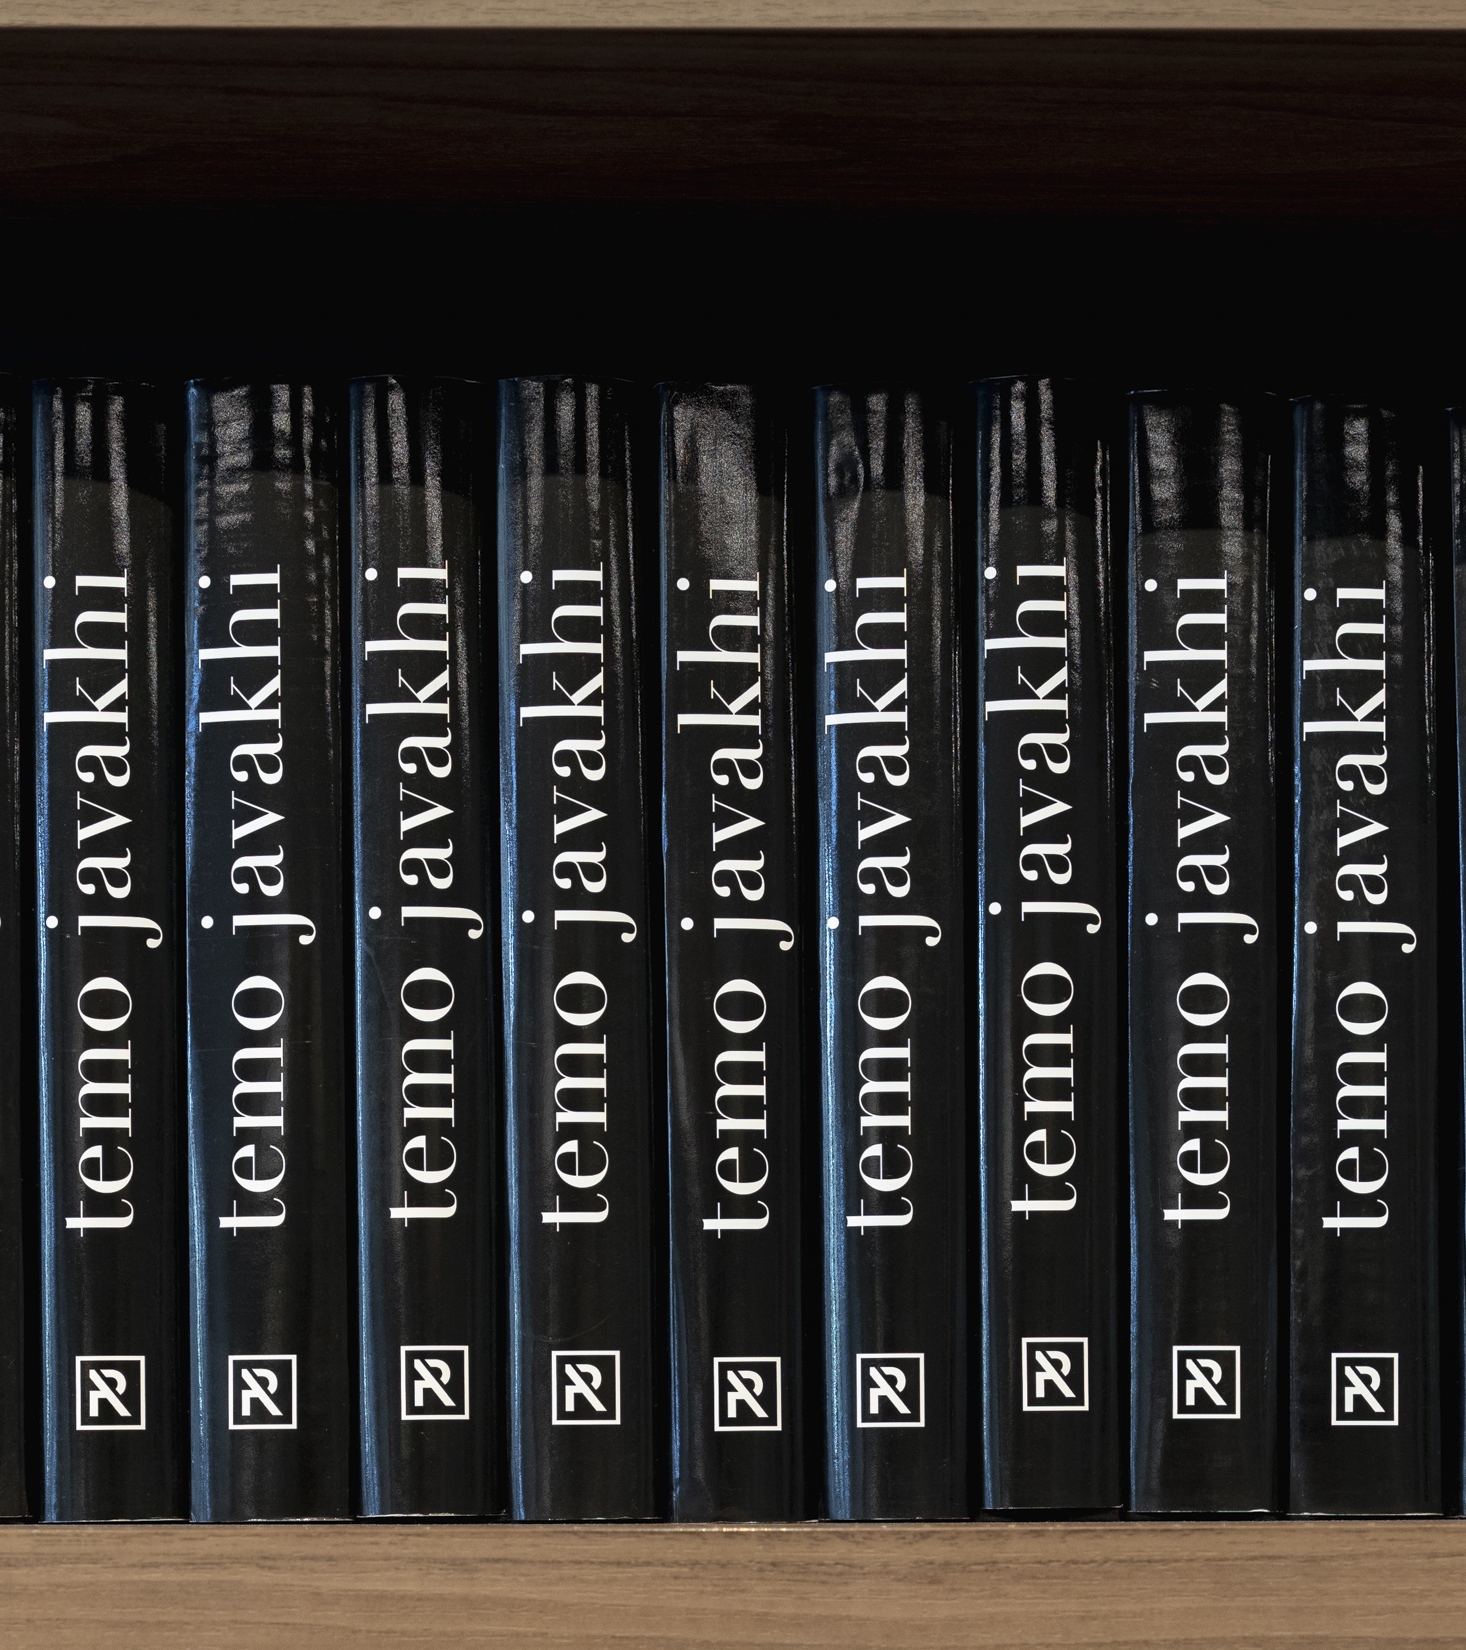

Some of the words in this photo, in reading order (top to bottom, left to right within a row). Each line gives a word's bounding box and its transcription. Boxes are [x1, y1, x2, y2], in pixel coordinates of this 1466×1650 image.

[43, 568, 163, 949] javakhi
[197, 563, 317, 945] javakhi
[364, 559, 484, 940] javakhi
[519, 561, 637, 943] javakhi
[676, 571, 795, 951] javakhi
[824, 568, 942, 947] javakhi
[983, 556, 1102, 934] javakhi
[1143, 569, 1260, 944] javakhi
[1302, 580, 1417, 954] javakhi
[64, 976, 134, 1238] temo
[218, 975, 286, 1237] temo
[389, 967, 457, 1228] temo
[541, 971, 609, 1232] temo
[702, 978, 770, 1239] temo
[845, 975, 914, 1236] temo
[1009, 961, 1077, 1220] temo
[1162, 972, 1231, 1229] temo
[1321, 981, 1389, 1237] temo
